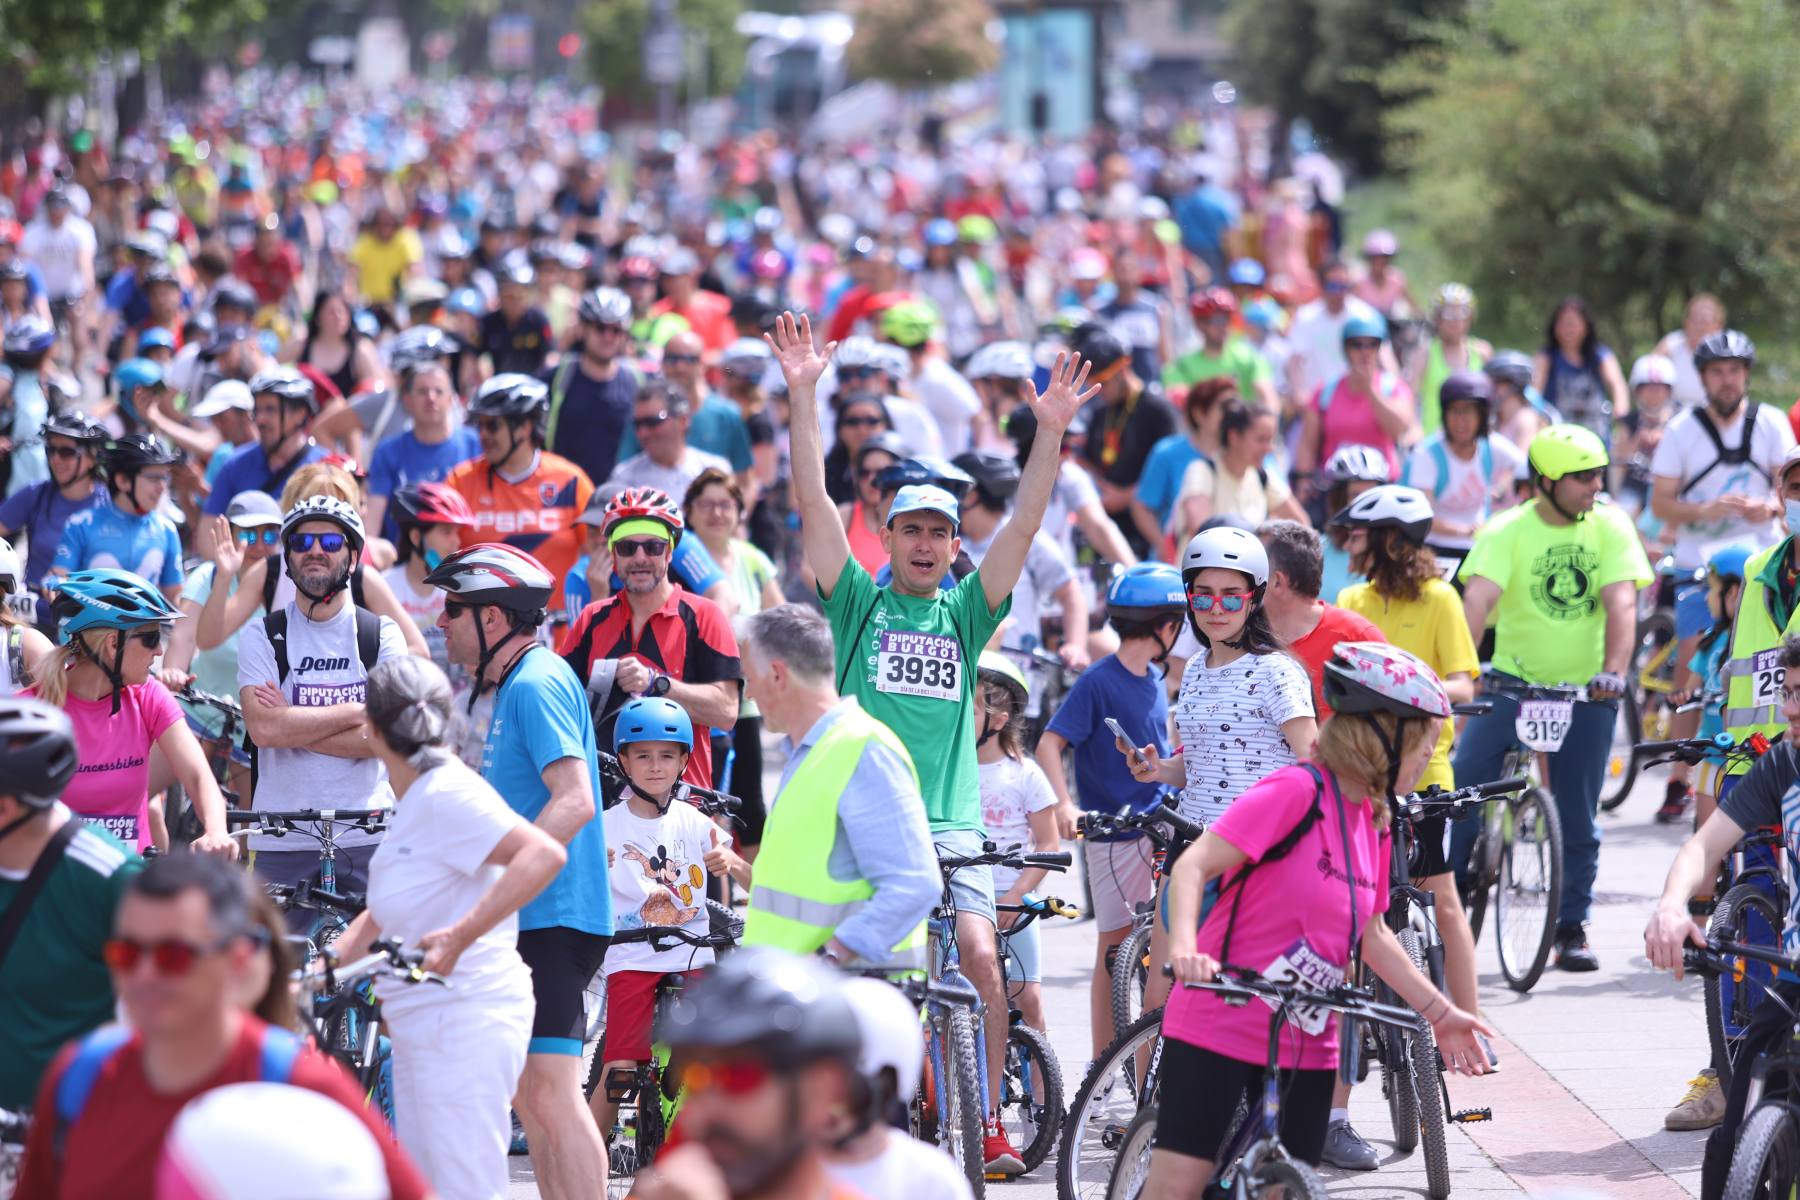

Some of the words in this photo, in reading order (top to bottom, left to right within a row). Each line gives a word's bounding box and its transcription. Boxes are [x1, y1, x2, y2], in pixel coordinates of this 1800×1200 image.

[887, 641, 958, 660] BURGOS
[888, 633, 957, 651] DIPUTACIÓN
[294, 656, 350, 676] Penn
[886, 655, 956, 689] 3933
[298, 694, 366, 706] BURGOS
[299, 684, 366, 698] DIPUTACIÓN
[1150, 1035, 1165, 1075] ZOOM
